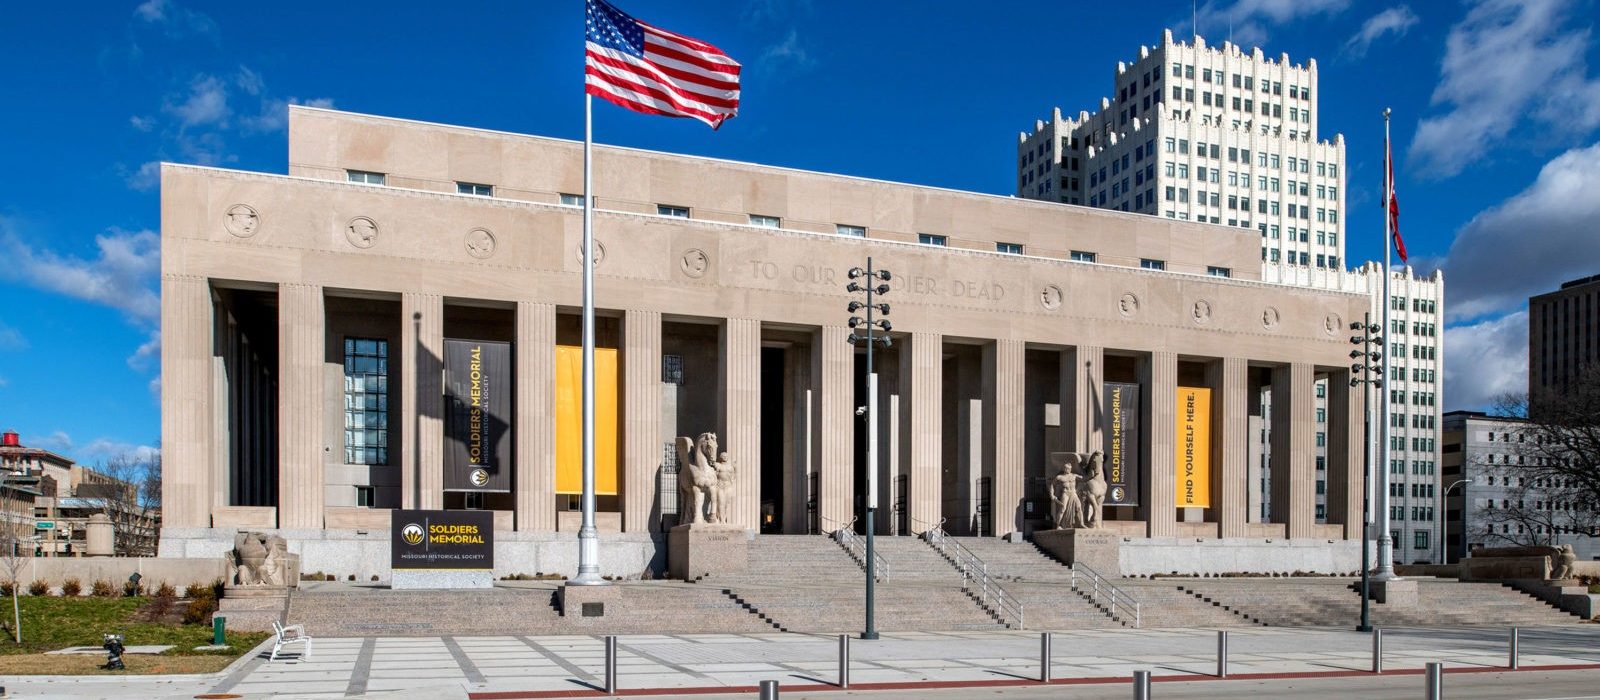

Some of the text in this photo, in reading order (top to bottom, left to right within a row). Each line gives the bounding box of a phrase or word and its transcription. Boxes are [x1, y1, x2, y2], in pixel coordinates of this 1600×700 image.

[750, 260, 778, 280] TO
[793, 264, 837, 287] OUR
[954, 280, 1005, 301] DEAD
[470, 345, 481, 463] SOLDIERS MEMORIAL
[1186, 392, 1194, 422] HERE.
[1112, 387, 1121, 483] SOLDIERS MEMORIAL
[1185, 424, 1194, 477] YOURSELF
[430, 525, 478, 534] SOLDIERS
[430, 535, 485, 544] MEMORIAL
